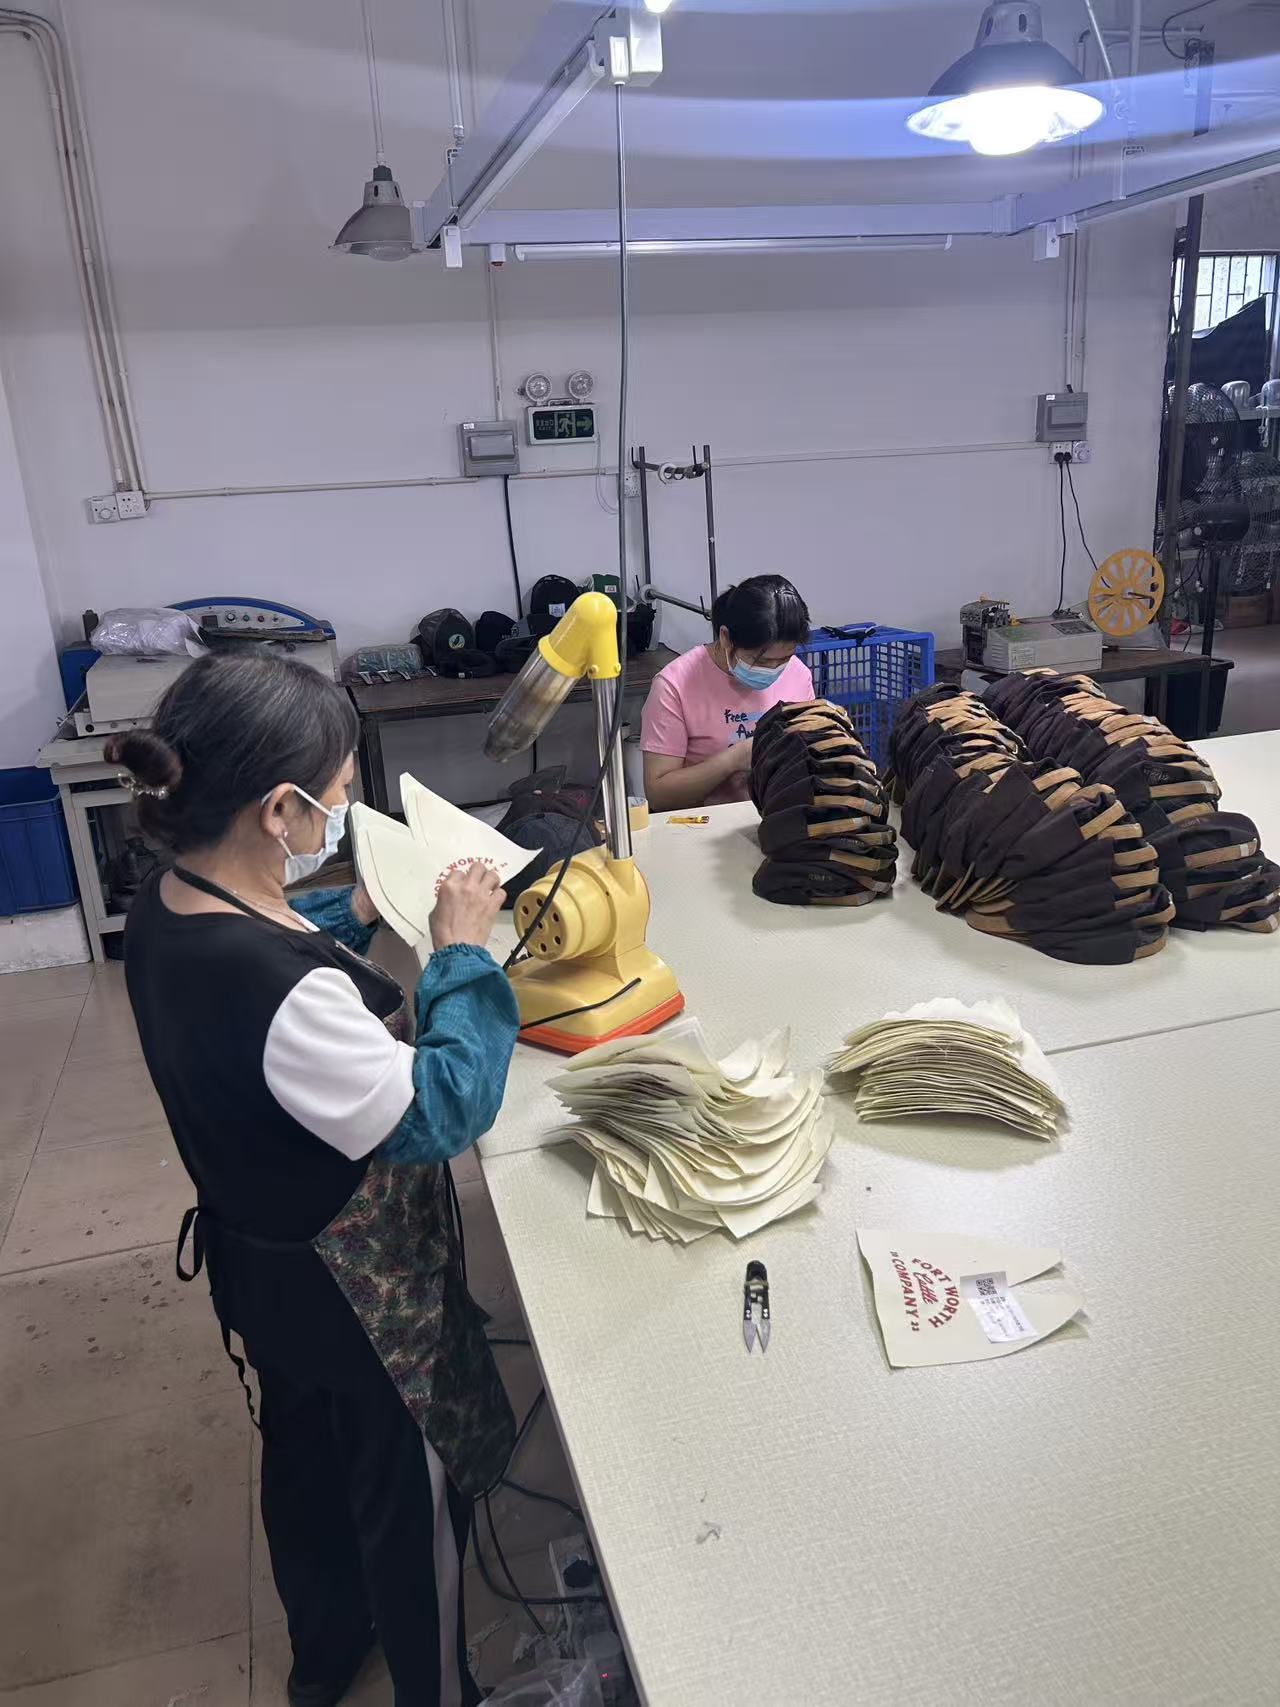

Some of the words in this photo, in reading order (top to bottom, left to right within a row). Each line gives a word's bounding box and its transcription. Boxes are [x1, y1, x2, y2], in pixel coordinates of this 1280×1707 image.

[892, 1258, 919, 1318] COMPANY
[912, 1258, 952, 1282] FORT
[928, 1286, 960, 1328] WORTH
